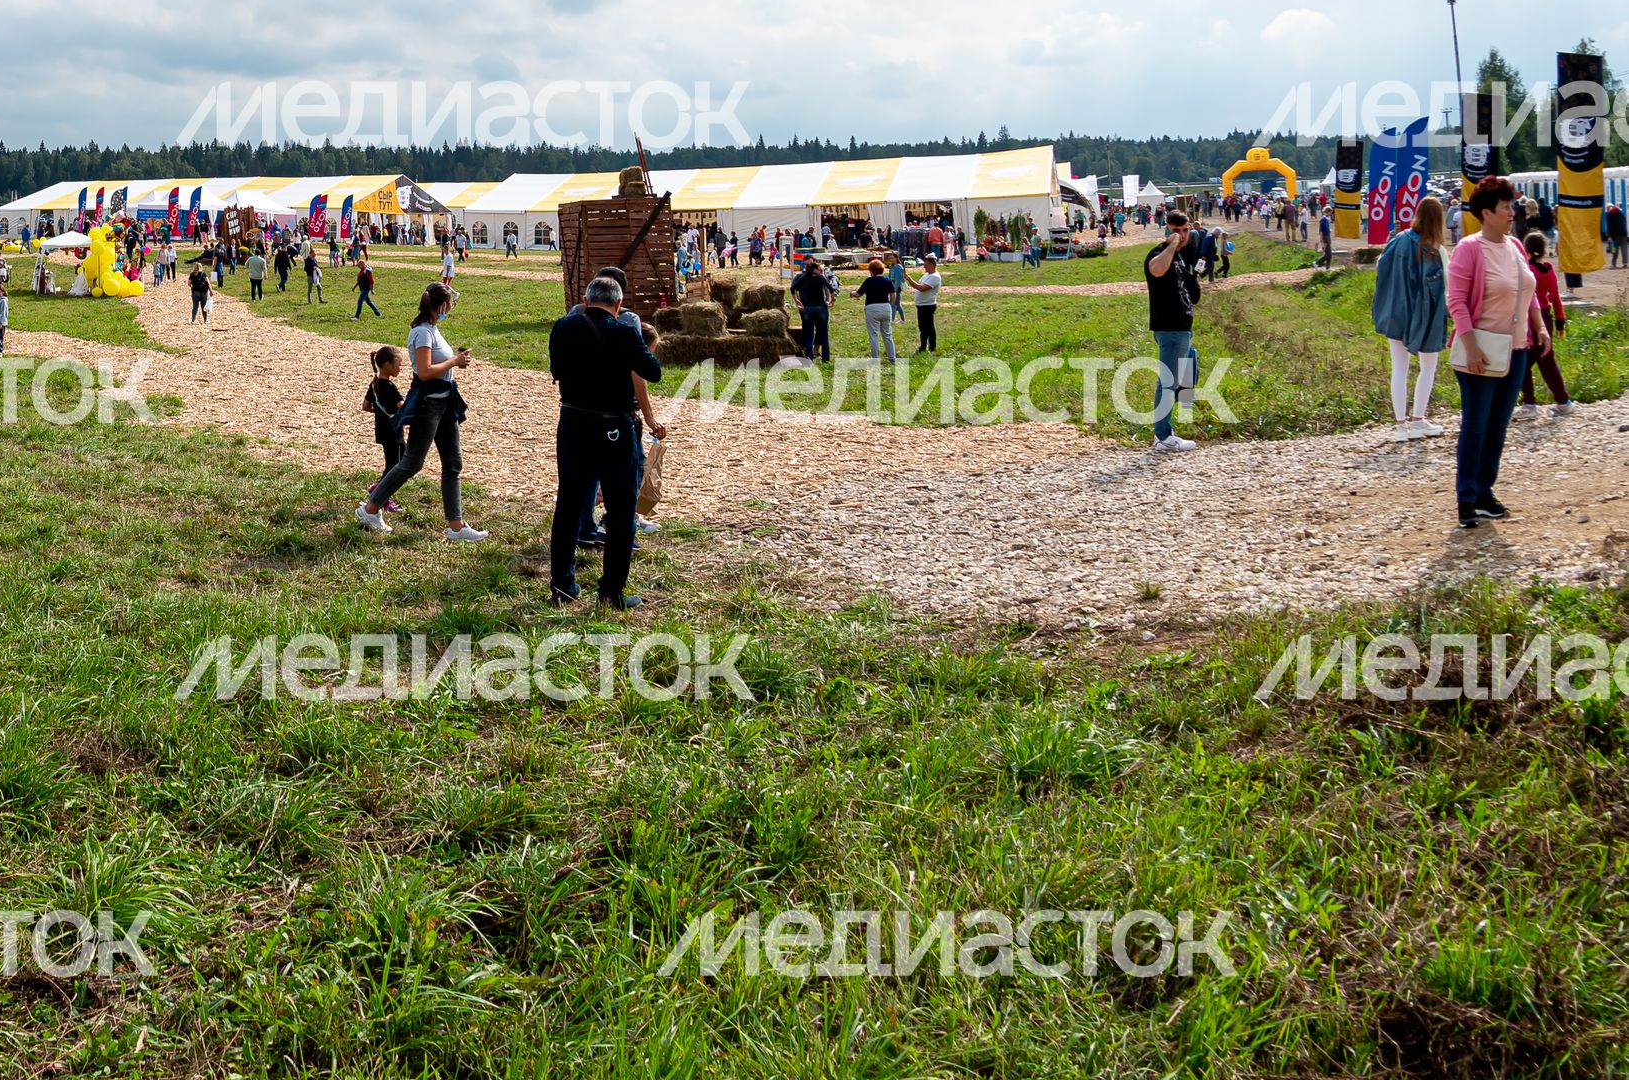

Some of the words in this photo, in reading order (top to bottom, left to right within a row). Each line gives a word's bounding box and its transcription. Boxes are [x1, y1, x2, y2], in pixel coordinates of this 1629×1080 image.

[378, 190, 392, 200] СЫР
[1371, 160, 1396, 221] OZON
[1398, 154, 1428, 223] OZON
[189, 200, 201, 226] OZON
[378, 200, 392, 210] ТУТ!
[341, 206, 353, 230] OZON
